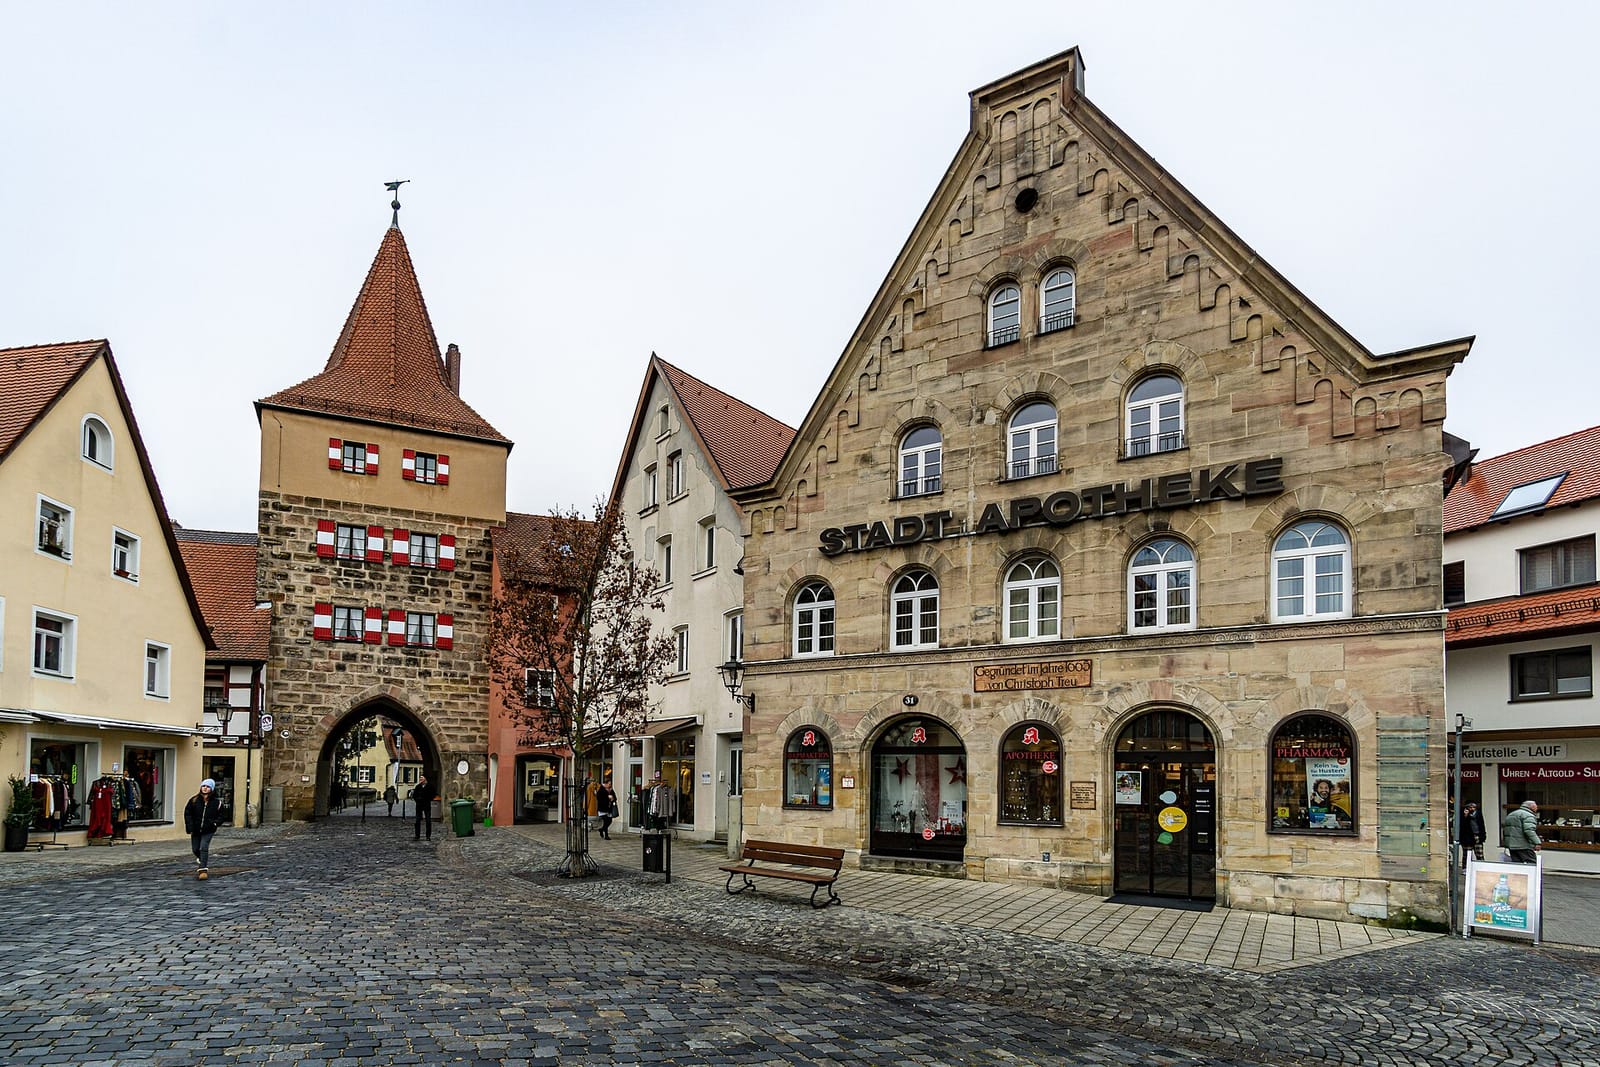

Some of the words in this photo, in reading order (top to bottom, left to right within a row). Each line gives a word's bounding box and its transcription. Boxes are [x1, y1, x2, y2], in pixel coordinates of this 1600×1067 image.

[818, 510, 953, 556] STADT
[977, 457, 1286, 532] APOTHEKE
[975, 664, 1026, 679] Gegründet
[1027, 663, 1039, 675] im
[1040, 662, 1066, 677] Jahre
[987, 681, 1004, 690] von
[1005, 676, 1054, 689] Christoph
[1056, 676, 1077, 687] Treu
[904, 696, 915, 705] 31
[1006, 751, 1056, 760] APOTHEKE
[1277, 748, 1348, 758] PHARMACY
[1448, 747, 1518, 759] akaufstelle
[1528, 745, 1561, 757] LAUF
[1447, 768, 1480, 778] MNZEN
[1502, 767, 1530, 778] UHREN
[1537, 767, 1575, 778] ALTGOLD
